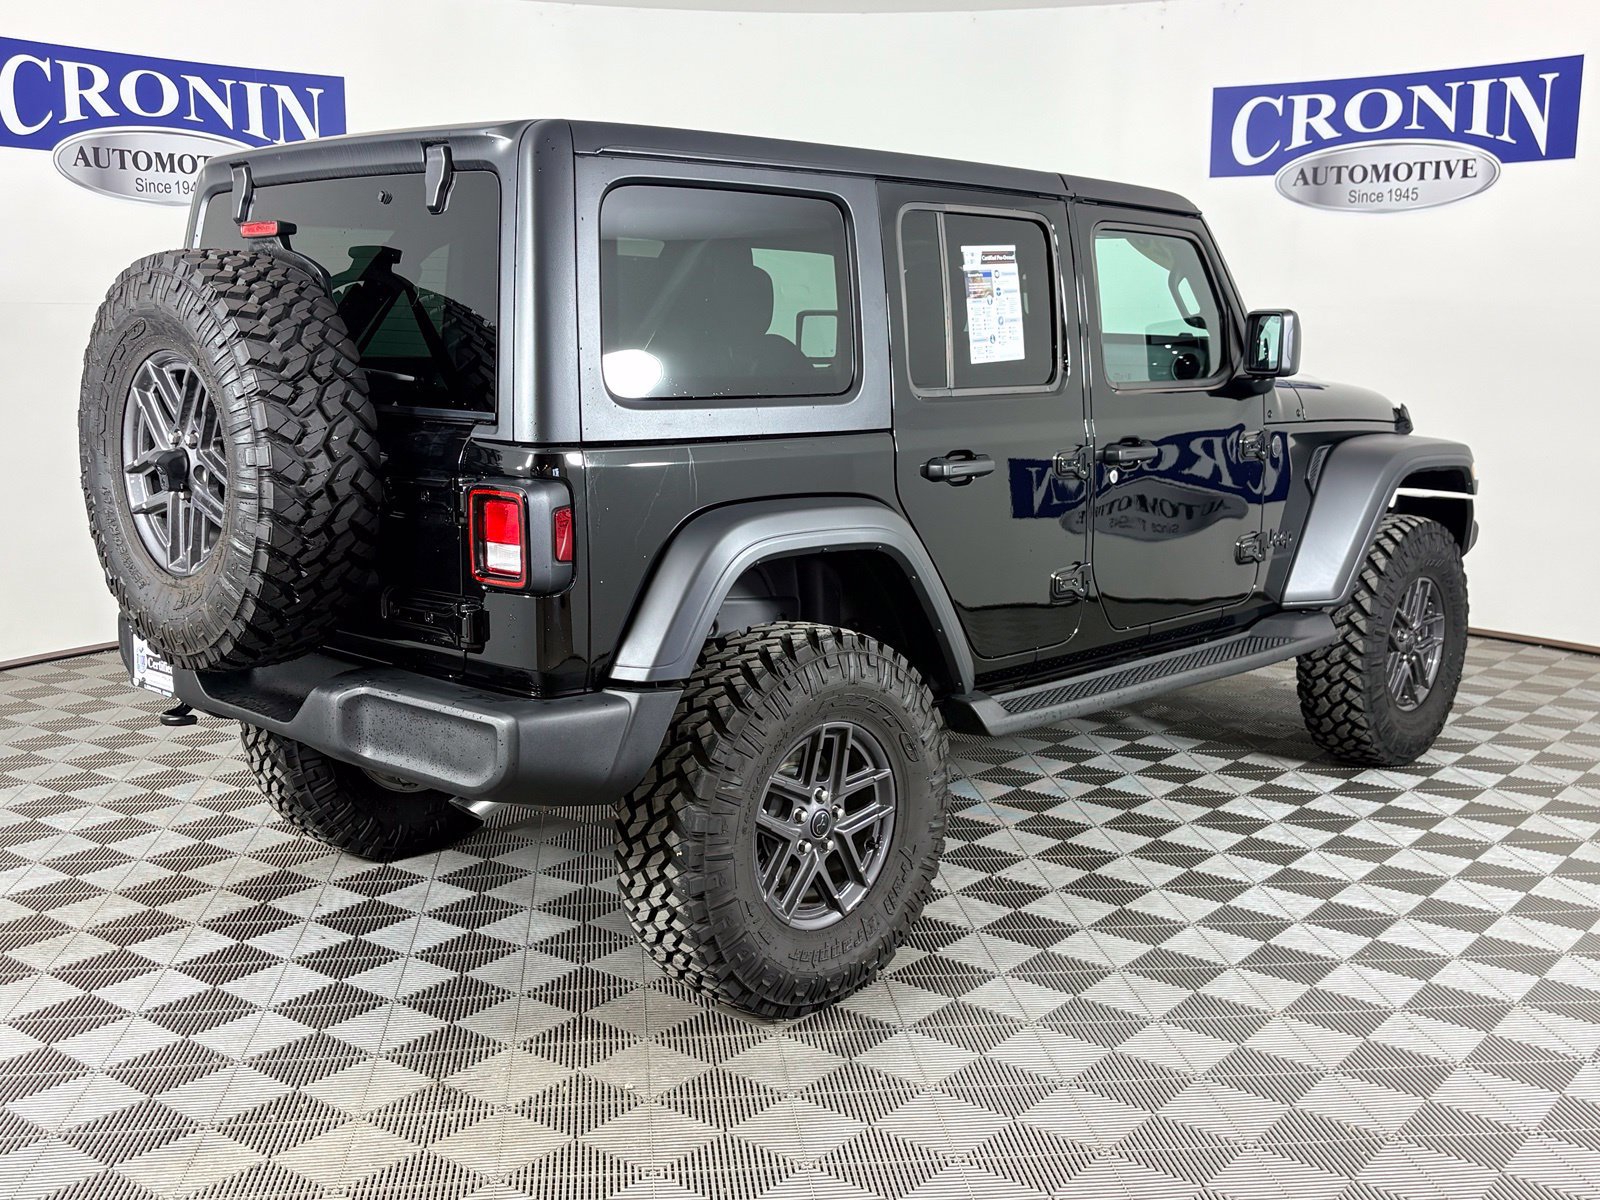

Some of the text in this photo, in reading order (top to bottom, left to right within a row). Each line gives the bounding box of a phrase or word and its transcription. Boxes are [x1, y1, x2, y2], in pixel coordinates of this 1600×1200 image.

[0, 54, 324, 143] CRONIN
[1230, 72, 1560, 166] CRONIN
[73, 145, 213, 175] AUTOMO
[1293, 158, 1477, 187] AUTOMOTIVE
[135, 177, 196, 195] Since 194
[1348, 187, 1419, 204] Since 1945
[1267, 529, 1292, 549] Jeep
